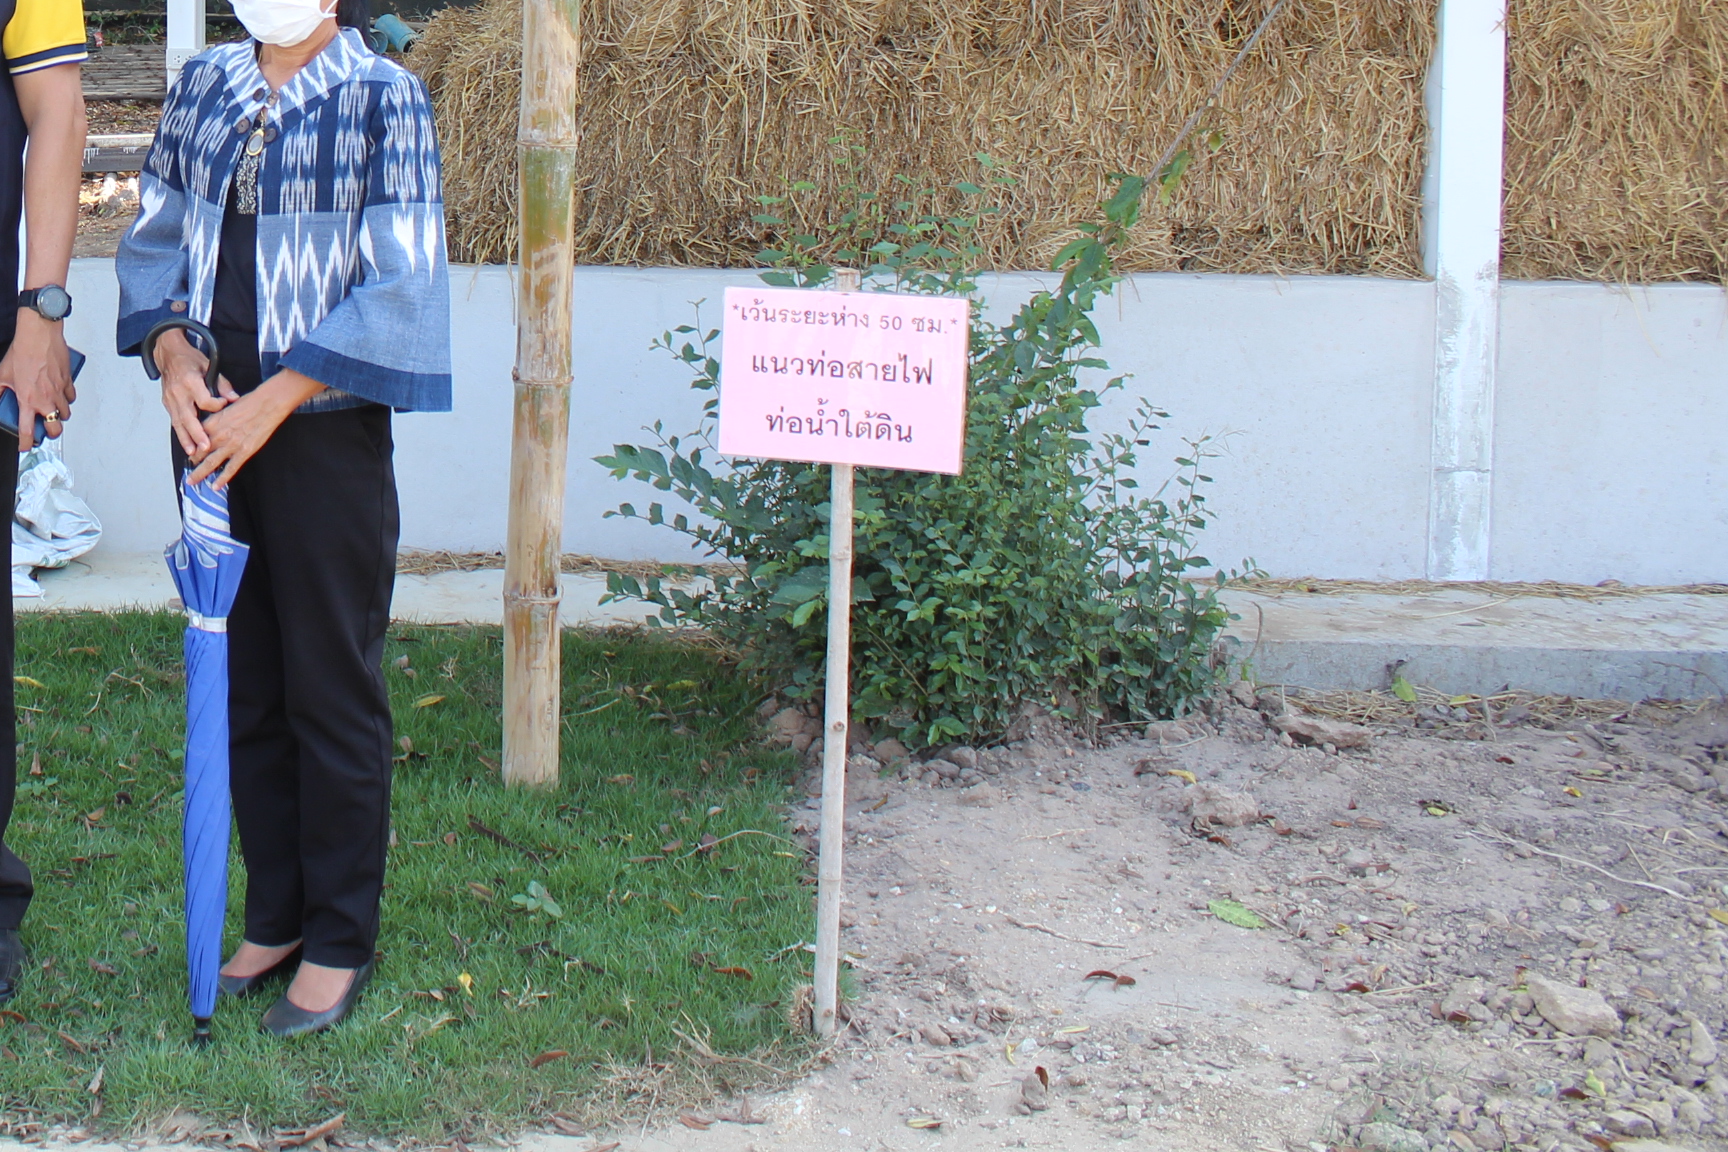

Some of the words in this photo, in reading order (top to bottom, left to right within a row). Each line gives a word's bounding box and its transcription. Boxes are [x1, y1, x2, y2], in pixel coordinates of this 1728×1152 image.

[879, 315, 903, 331] 50
[751, 350, 934, 386] แนวท่อสายไฟ
[765, 398, 914, 444] ท่อน้ำใต้ดิน
